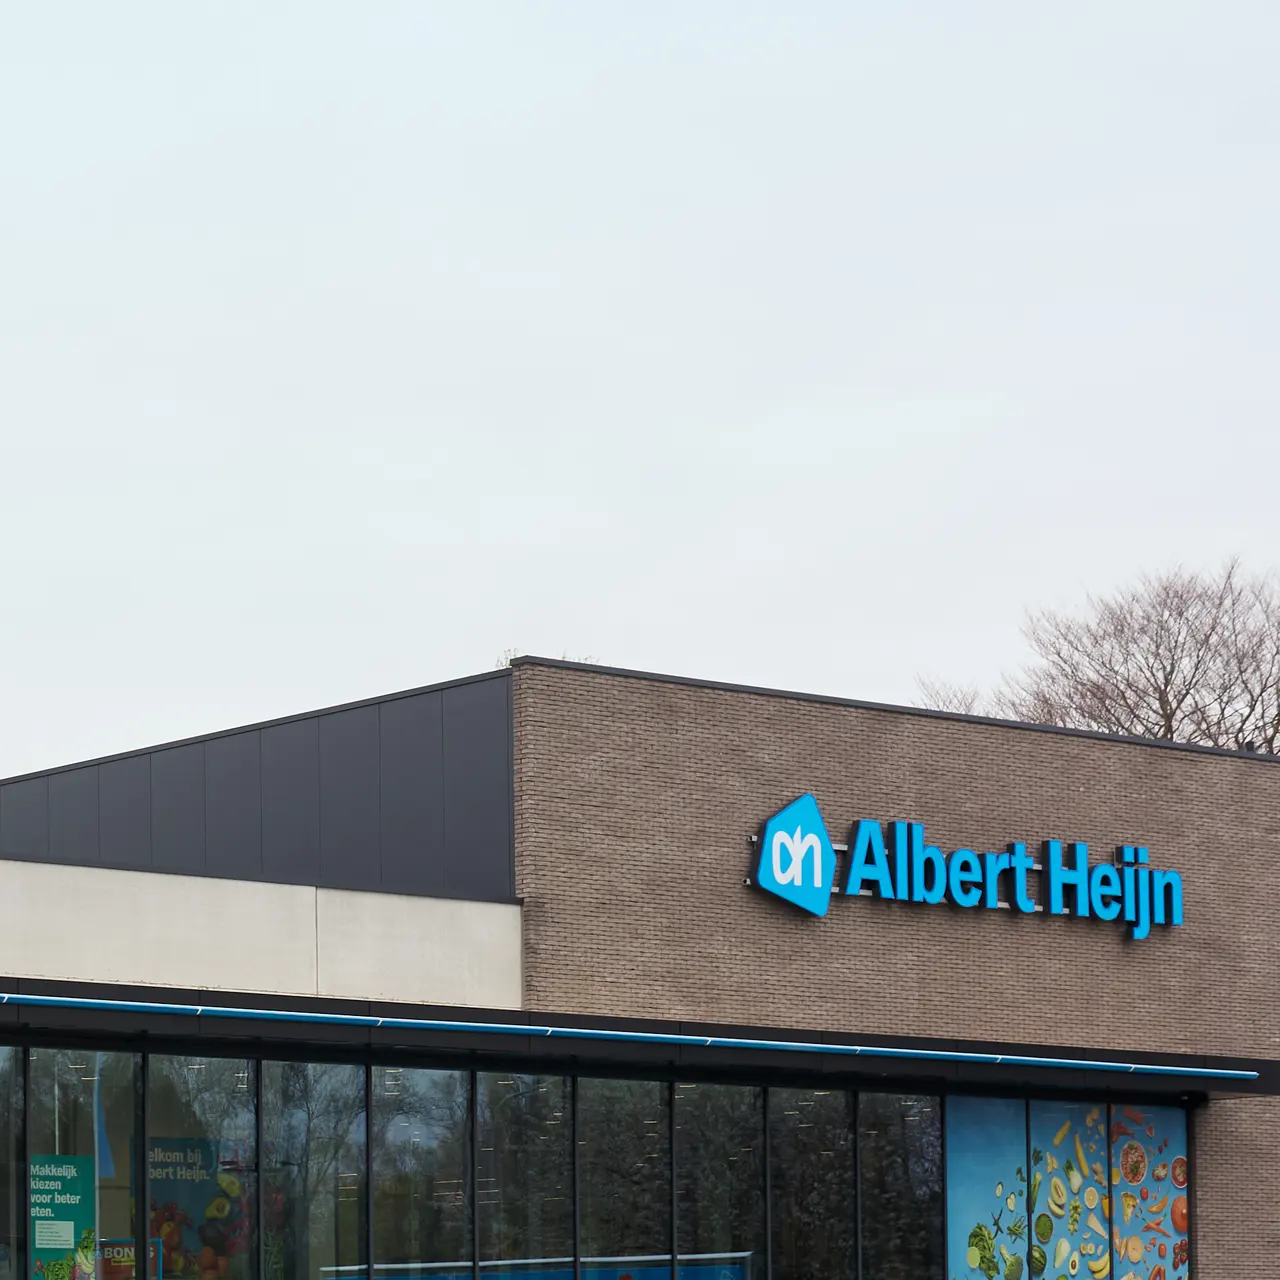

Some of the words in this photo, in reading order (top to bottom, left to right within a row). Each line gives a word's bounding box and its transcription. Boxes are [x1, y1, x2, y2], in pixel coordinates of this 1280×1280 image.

[844, 818, 1036, 914] Albert
[1042, 838, 1185, 941] Heijn
[148, 1147, 184, 1163] elkom
[187, 1148, 202, 1165] bij
[30, 1164, 78, 1179] Makkelijk
[148, 1165, 175, 1180] bert
[176, 1166, 211, 1184] Heijn.
[30, 1178, 62, 1190] kiezen
[30, 1194, 52, 1204] voor
[54, 1192, 81, 1205] beter
[30, 1206, 55, 1217] eten.
